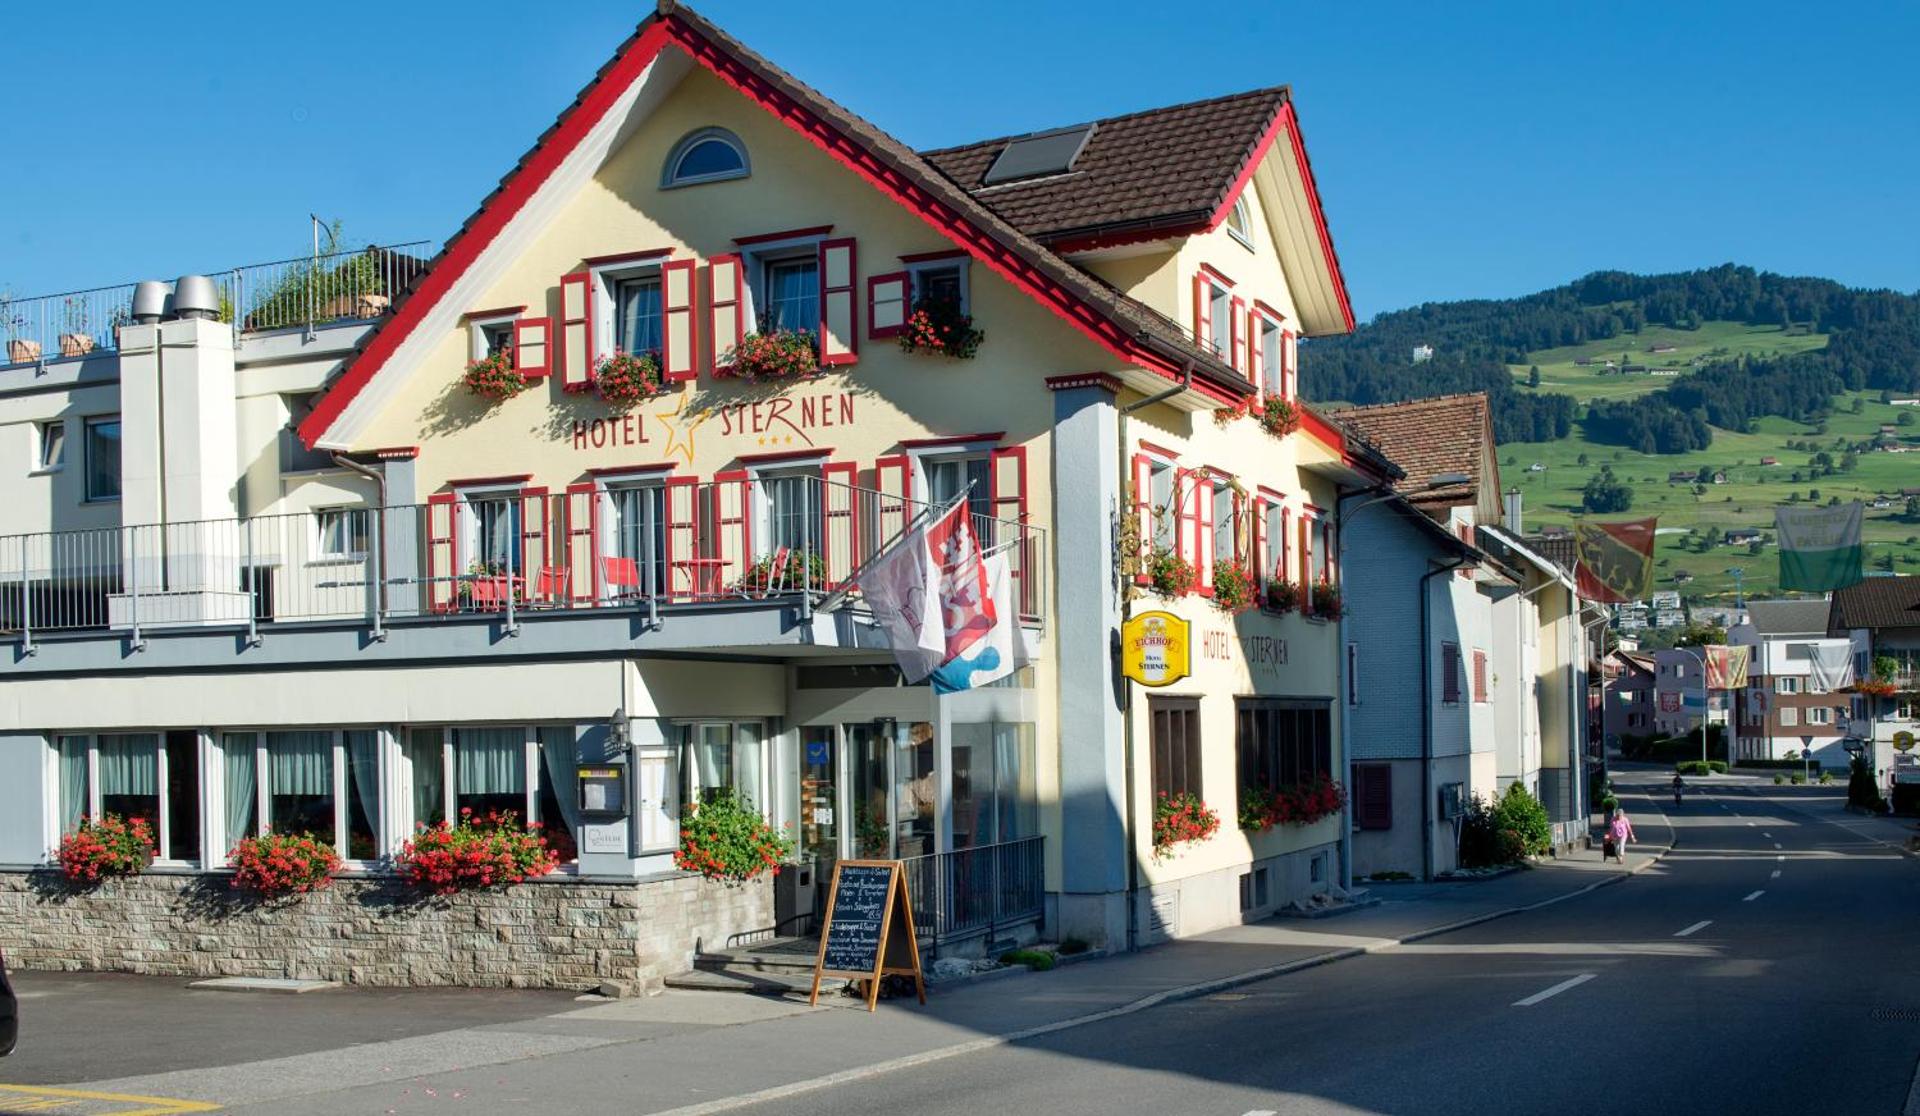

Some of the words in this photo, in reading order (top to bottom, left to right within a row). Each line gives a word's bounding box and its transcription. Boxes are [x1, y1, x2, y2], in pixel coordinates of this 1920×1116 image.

[573, 414, 649, 450] HOTEL
[721, 394, 854, 447] STERNEN
[1135, 637, 1174, 647] EICHHOF
[1203, 630, 1230, 660] HOTEL
[1251, 636, 1289, 677] STERNEN
[1138, 662, 1170, 670] STERNEN
